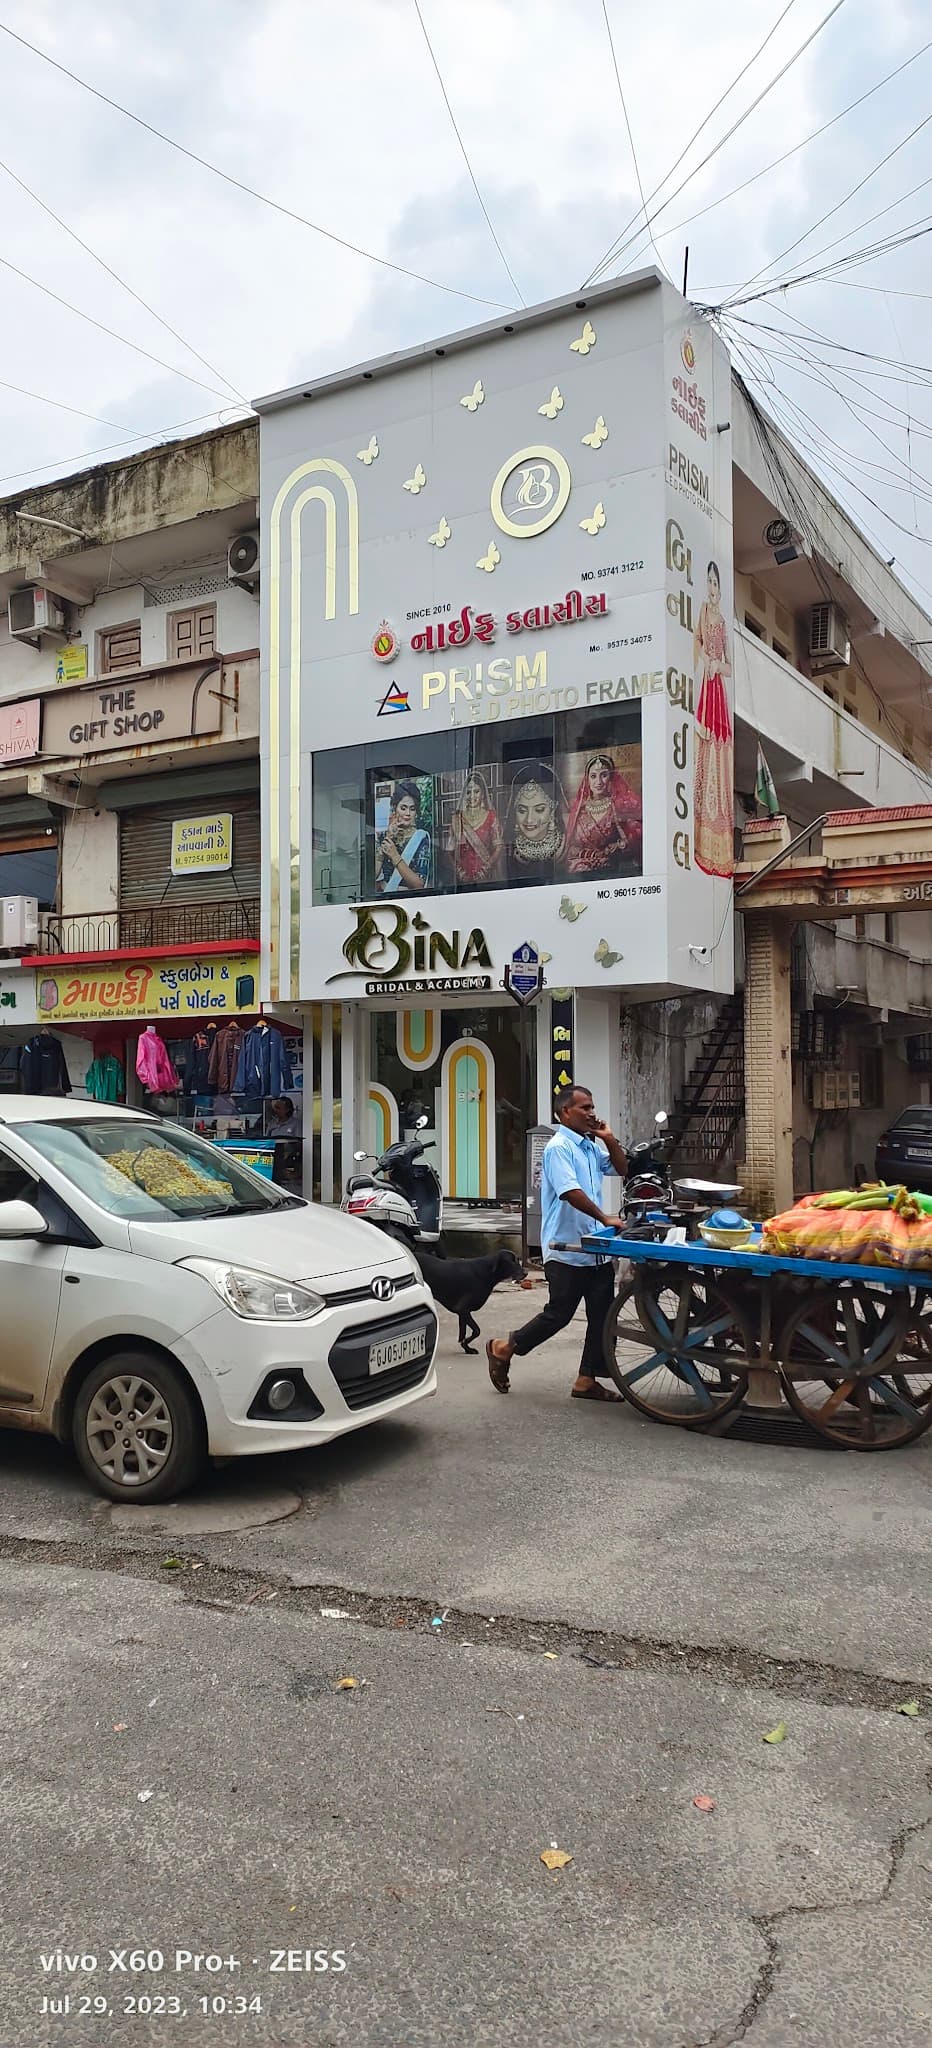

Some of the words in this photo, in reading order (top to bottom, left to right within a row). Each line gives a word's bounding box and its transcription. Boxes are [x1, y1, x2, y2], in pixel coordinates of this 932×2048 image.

[669, 443, 709, 502] PRISM
[597, 566, 619, 578] 93741
[621, 561, 644, 573] 31212
[406, 608, 431, 620] SINCE
[433, 603, 452, 615] 2010
[607, 639, 629, 649] 95375
[630, 635, 653, 645] 34075
[421, 651, 548, 710] PRISM
[99, 690, 136, 715] THE
[507, 686, 579, 718] PHOTO
[585, 670, 664, 704] FRAME
[69, 719, 110, 744] GIFT
[113, 709, 165, 737] SHOP
[181, 826, 203, 841] દુકાન
[205, 820, 224, 834] ભાડે
[177, 836, 214, 852] આપવાની
[184, 855, 204, 864] 97254
[206, 853, 228, 862] 99014
[613, 888, 637, 898] 96015
[638, 885, 662, 895] 76896
[63, 964, 154, 1007] માણકી
[221, 966, 229, 979] &
[368, 982, 412, 993] BRIDAL
[415, 981, 424, 991] &
[427, 977, 486, 991] ACADEMY
[160, 990, 181, 1010] પર્સ
